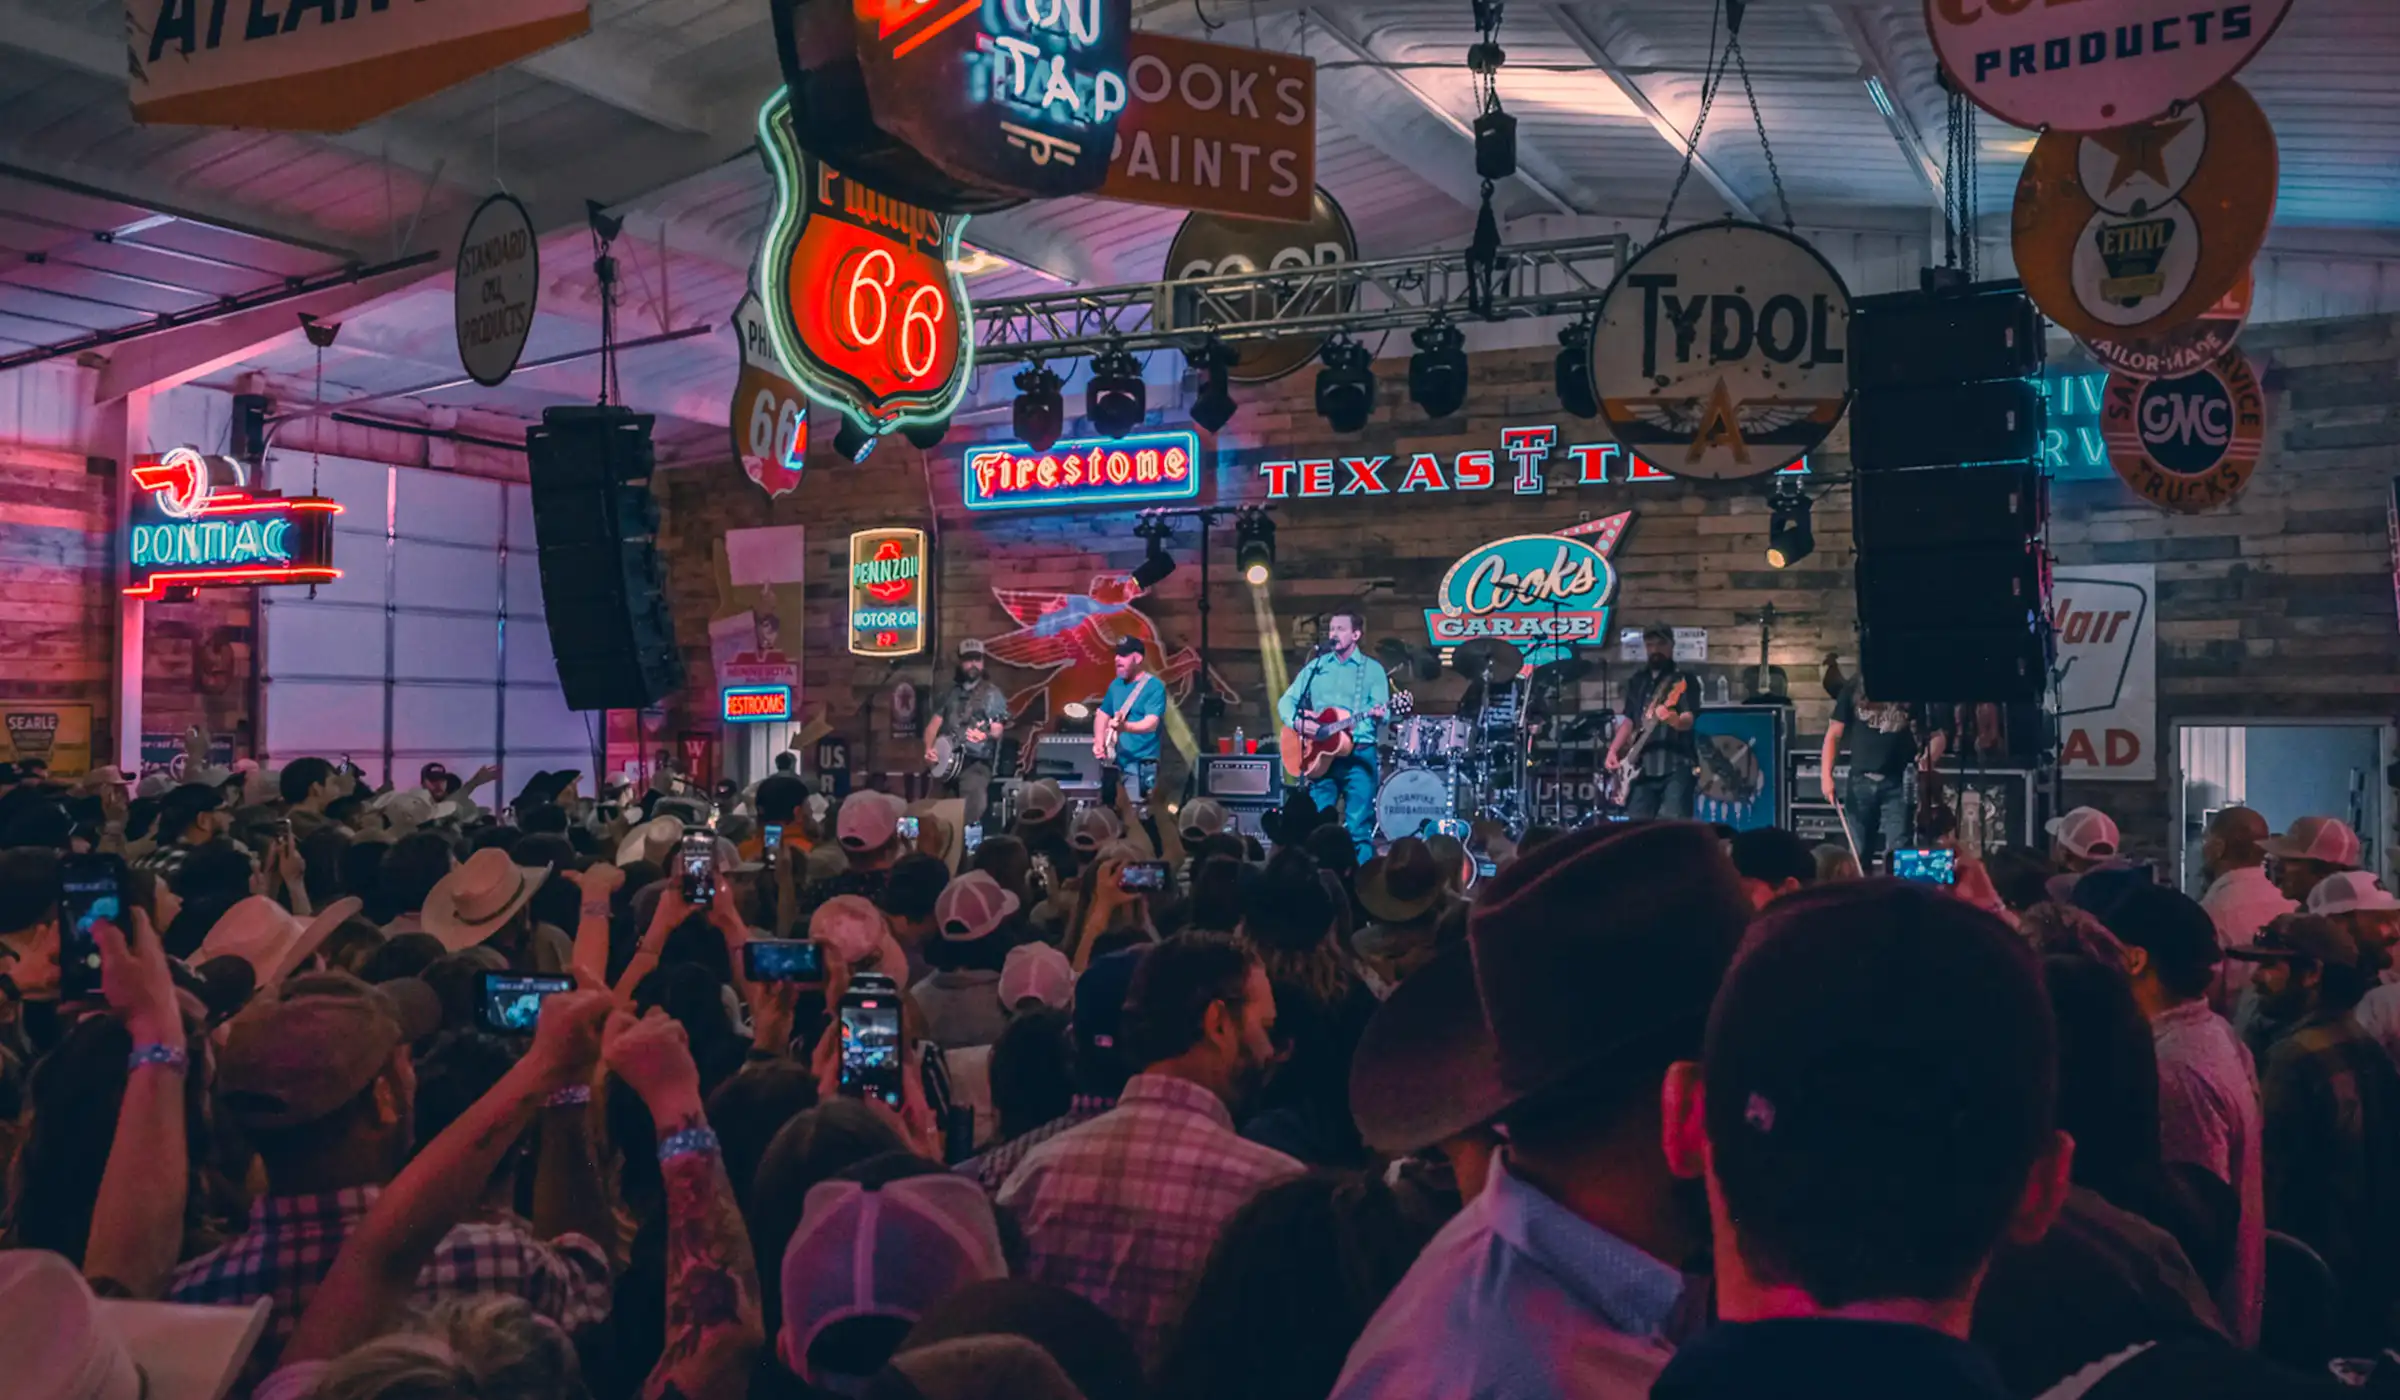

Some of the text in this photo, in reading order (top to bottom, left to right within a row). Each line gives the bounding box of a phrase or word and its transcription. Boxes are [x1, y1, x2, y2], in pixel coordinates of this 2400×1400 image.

[1974, 5, 2252, 83] PRODUCTS
[995, 36, 1127, 120] TAP
[1126, 55, 1306, 126] OOK'S
[462, 228, 527, 278] STANDARD
[2103, 222, 2168, 255] ETHYL
[482, 275, 506, 304] OIL
[848, 248, 944, 377] 66
[463, 302, 526, 350] PRODUCTS
[1627, 274, 1844, 378] TYDOL
[2143, 392, 2228, 446] GMC
[972, 447, 1188, 498] Firestone
[1260, 450, 1495, 498] TEXAS
[131, 518, 292, 565] PONTIAC
[853, 556, 919, 586] PENNZOIL
[854, 611, 917, 627] MOTOR OIL
[1436, 615, 1594, 638] GARAGE
[8, 715, 57, 731] SEARLE
